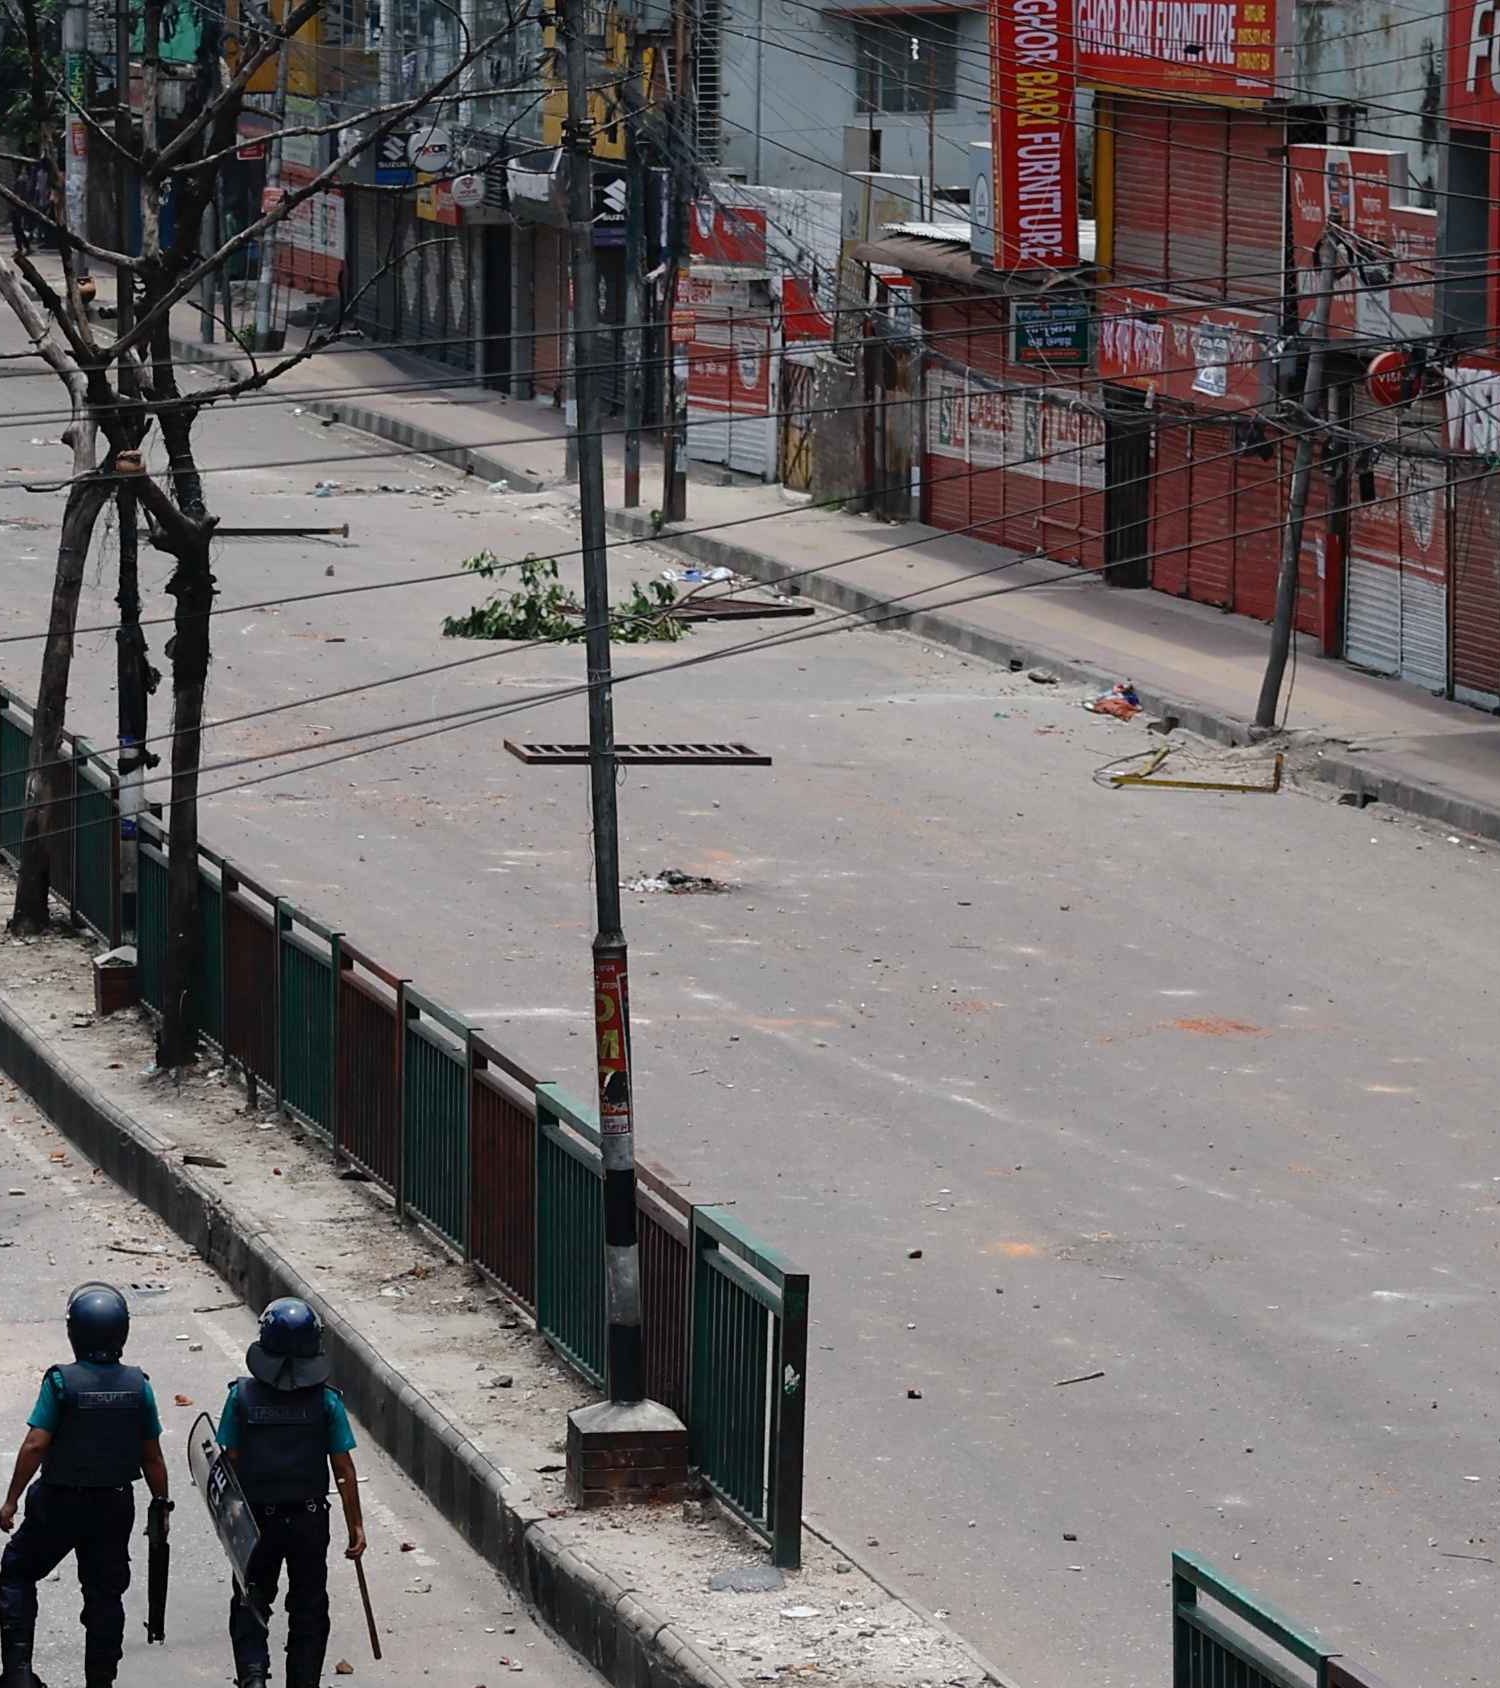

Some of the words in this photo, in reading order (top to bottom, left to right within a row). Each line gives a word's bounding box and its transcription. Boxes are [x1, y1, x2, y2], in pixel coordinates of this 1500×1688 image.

[1077, 0, 1115, 54] GHOR
[1119, 1, 1151, 58] BARI
[1155, 2, 1237, 65] FURNITURE
[1016, 71, 1060, 127] BARI
[1017, 132, 1063, 260] FURNITURE
